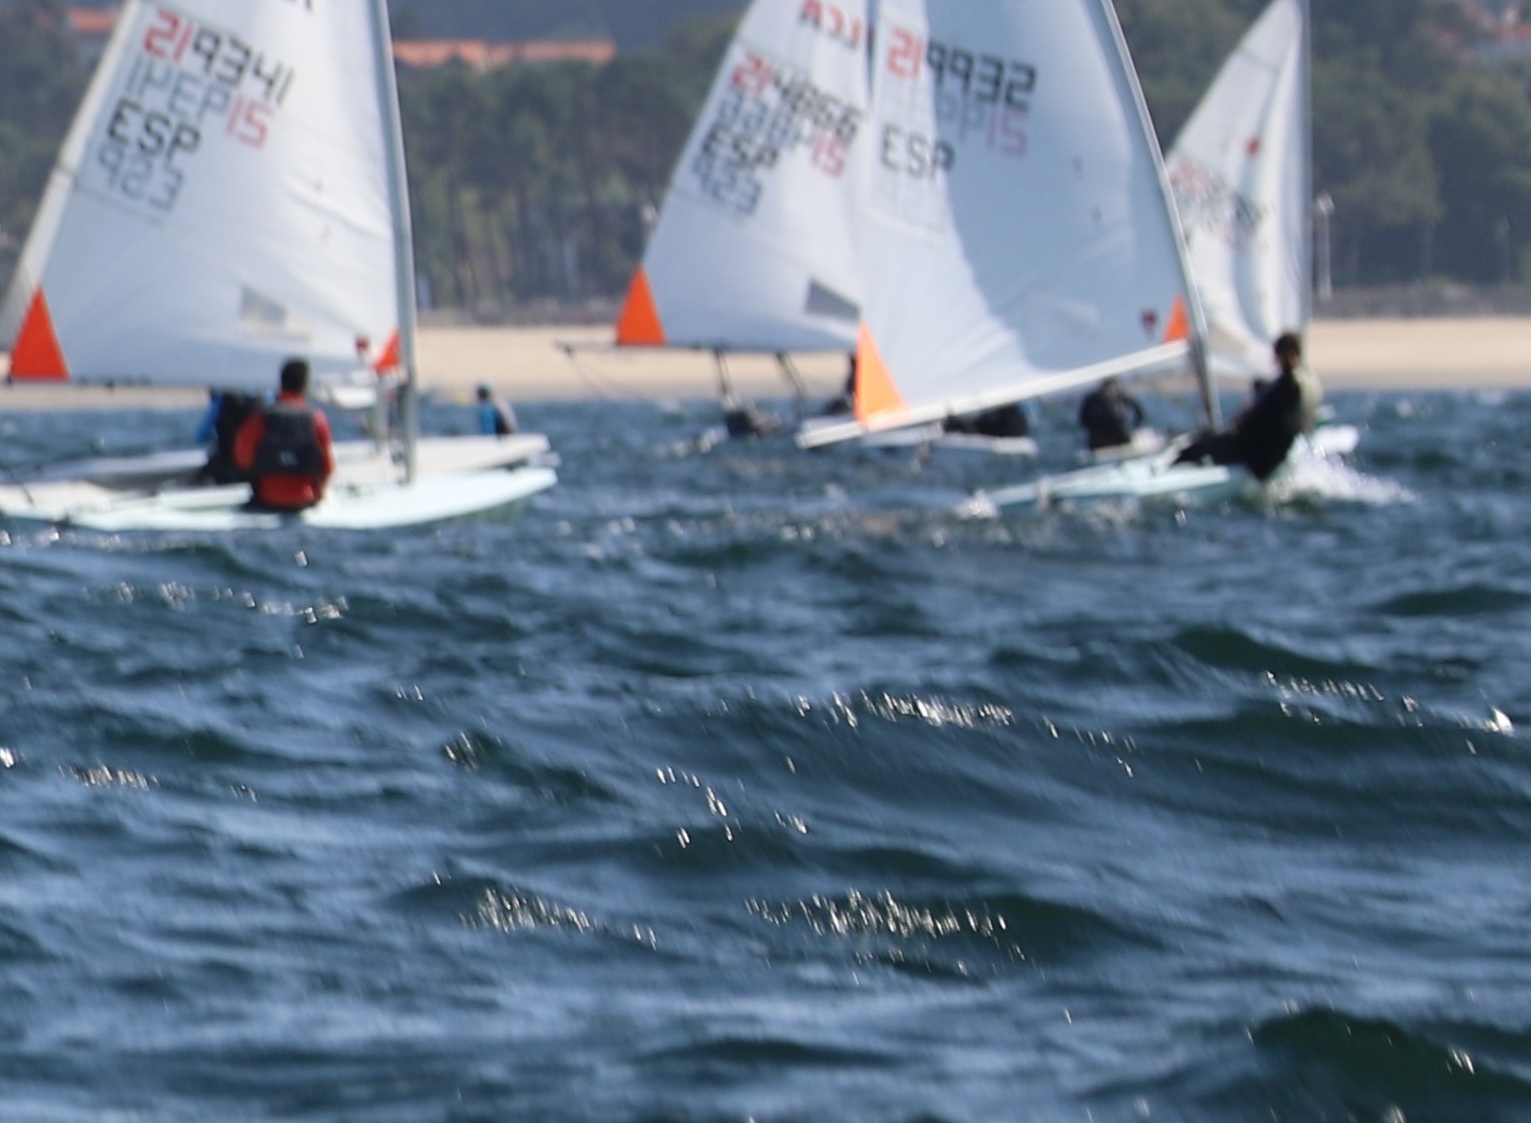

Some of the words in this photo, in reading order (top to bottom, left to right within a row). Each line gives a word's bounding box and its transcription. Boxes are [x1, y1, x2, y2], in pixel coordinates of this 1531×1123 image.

[142, 9, 295, 107] 219341
[887, 27, 1037, 112] 219932
[107, 99, 203, 160] ESP
[700, 123, 779, 169] ESP
[879, 123, 955, 183] ESP
